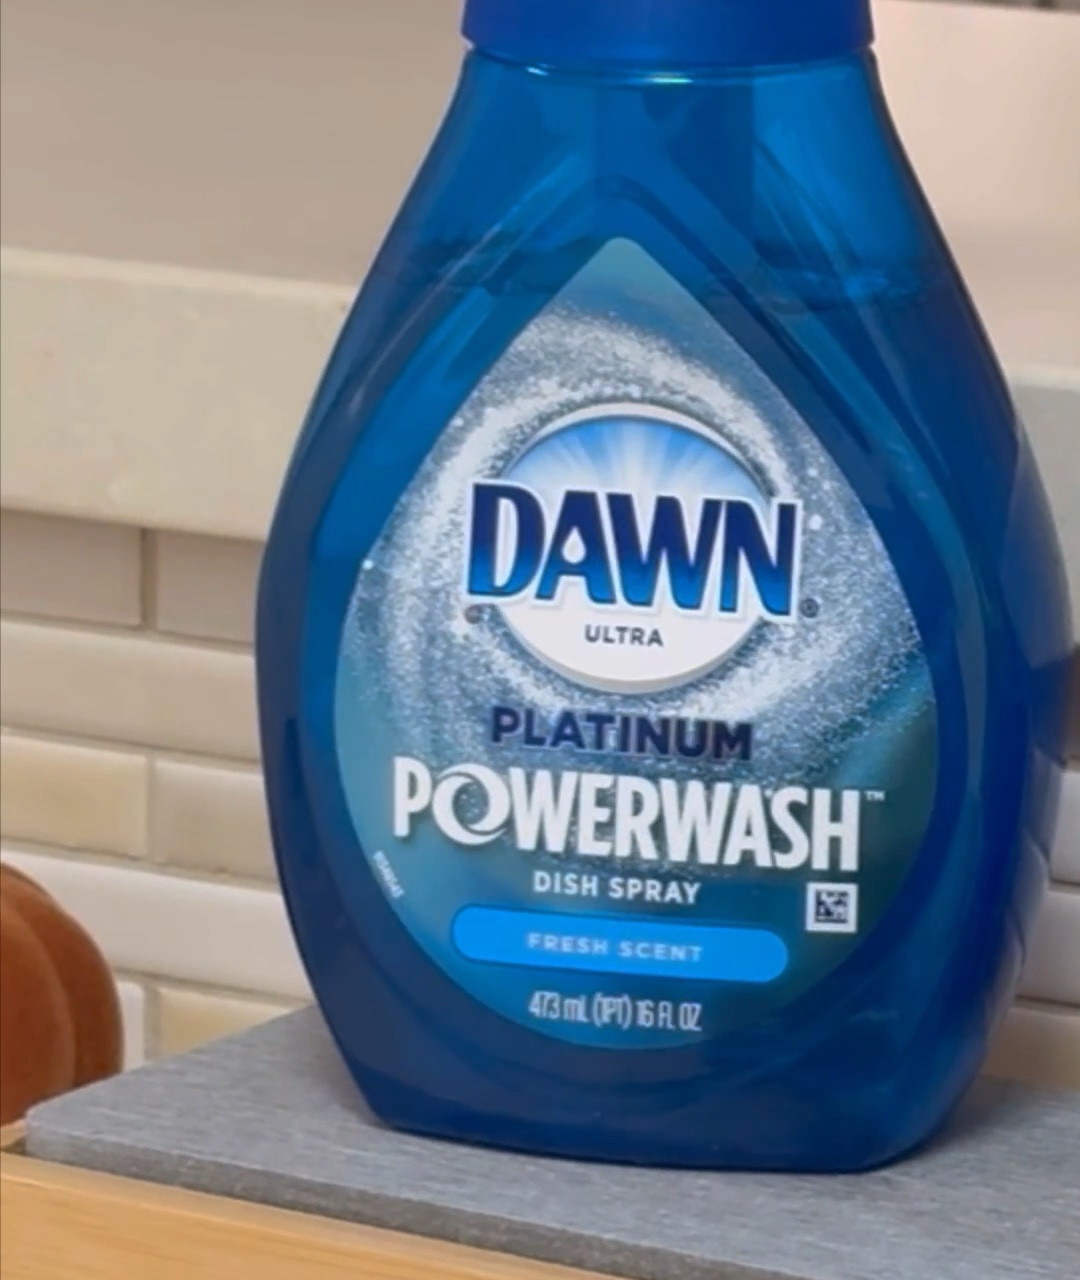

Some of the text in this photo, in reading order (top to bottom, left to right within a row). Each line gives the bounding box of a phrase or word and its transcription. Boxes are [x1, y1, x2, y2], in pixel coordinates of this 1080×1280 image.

[466, 482, 799, 617] DAWN
[585, 624, 664, 647] ULTRA
[490, 706, 754, 762] PLATINUM
[533, 870, 701, 904] DISH SPRAY
[527, 932, 702, 962] FRESH SCENT
[529, 990, 560, 1019] 473
[636, 999, 655, 1028] 16
[678, 1002, 702, 1032] OZ
